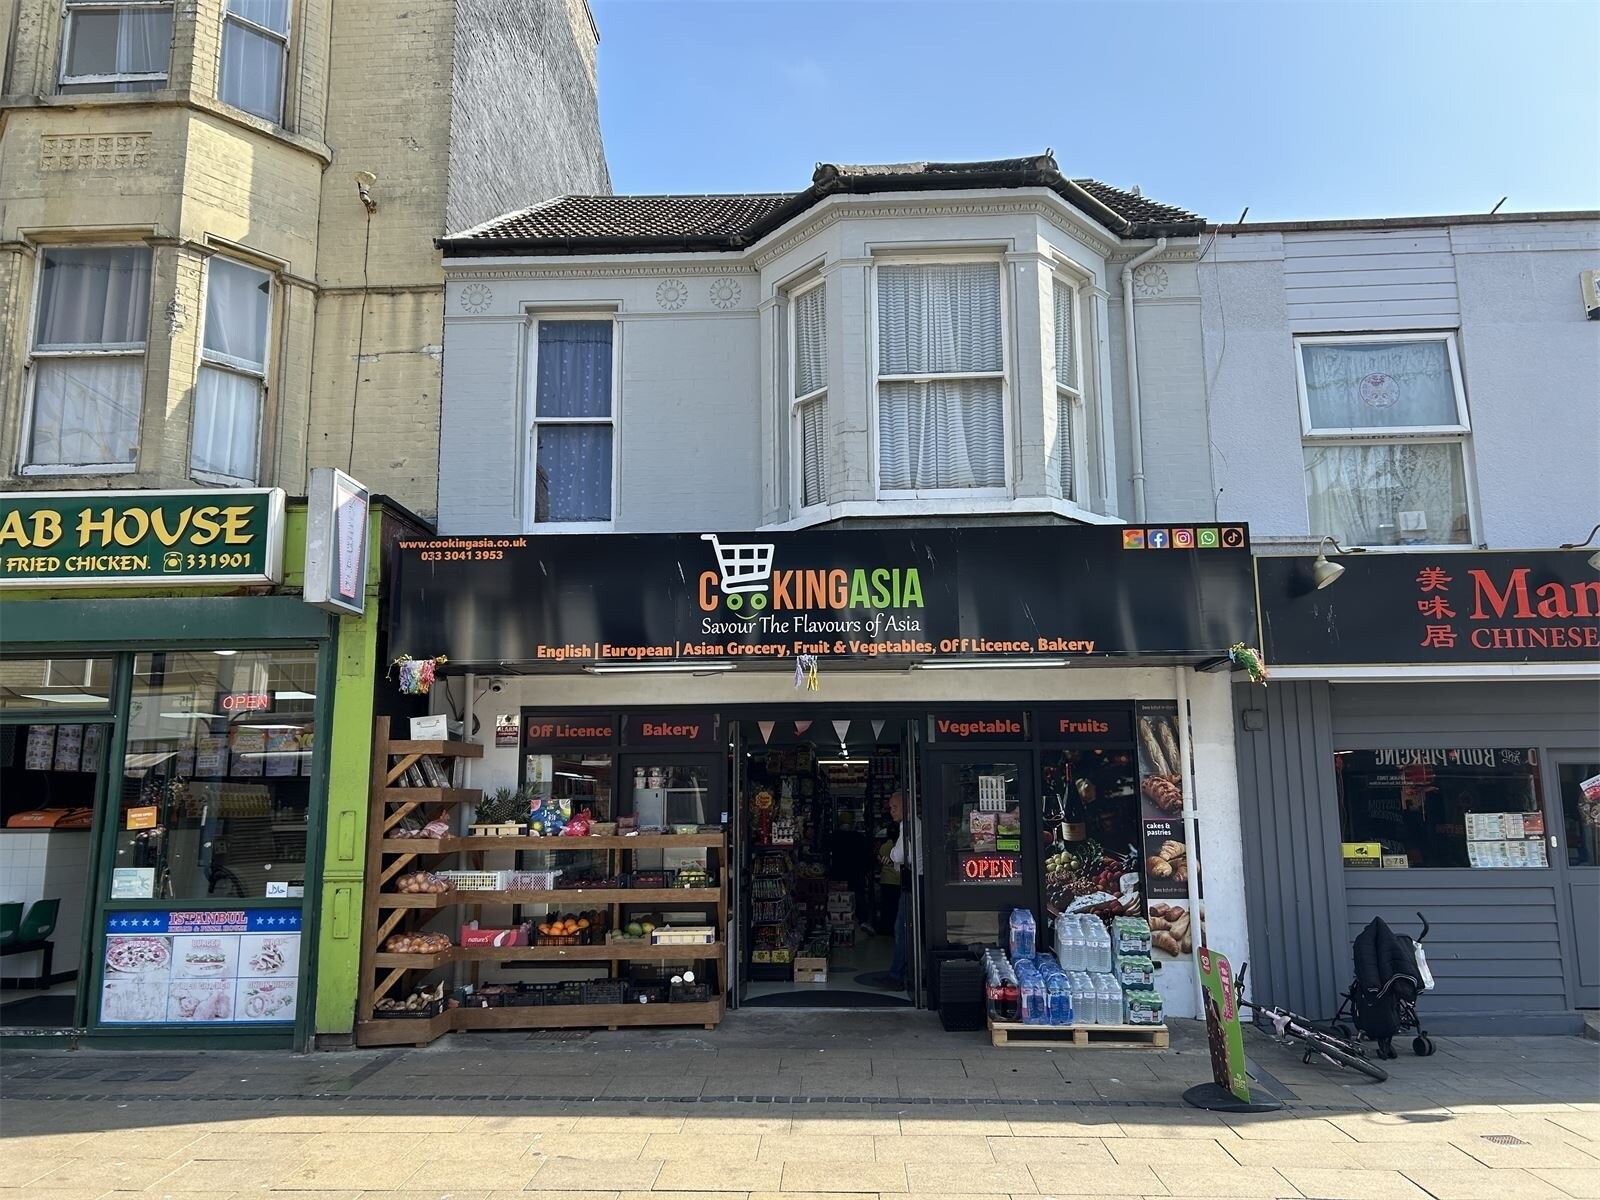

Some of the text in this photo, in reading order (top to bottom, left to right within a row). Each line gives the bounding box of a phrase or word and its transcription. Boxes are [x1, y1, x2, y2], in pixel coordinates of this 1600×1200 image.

[0, 506, 254, 548] AB HOUSE
[399, 538, 527, 550] www.cookingasia.co.uk
[6, 556, 60, 573] FRIED
[186, 552, 251, 570] 331901
[421, 550, 503, 561] 033 3041 3953
[1467, 567, 1600, 620] Man
[1415, 566, 1458, 648] 美味居
[701, 613, 921, 638] Savour The Flavours of Asia
[1471, 626, 1599, 649] CHINESE
[537, 643, 591, 660] English
[602, 642, 673, 660] European
[683, 641, 724, 656] Asian
[726, 641, 791, 658] Grocery,
[793, 639, 831, 654] Fruit
[833, 641, 846, 654] &
[848, 639, 937, 657] Vegetables,
[971, 638, 1035, 654] Licence,
[1037, 637, 1095, 656] Bakery
[222, 694, 268, 711] OPEN
[529, 724, 612, 738] Off Licence
[642, 723, 700, 740] Bakery
[938, 719, 1021, 737] Vegetable
[1059, 719, 1109, 734] Fruits
[1146, 822, 1164, 830] cakes
[1147, 829, 1172, 838] pastries
[965, 859, 1014, 879] OPEN
[169, 911, 248, 925] ISTANBUL
